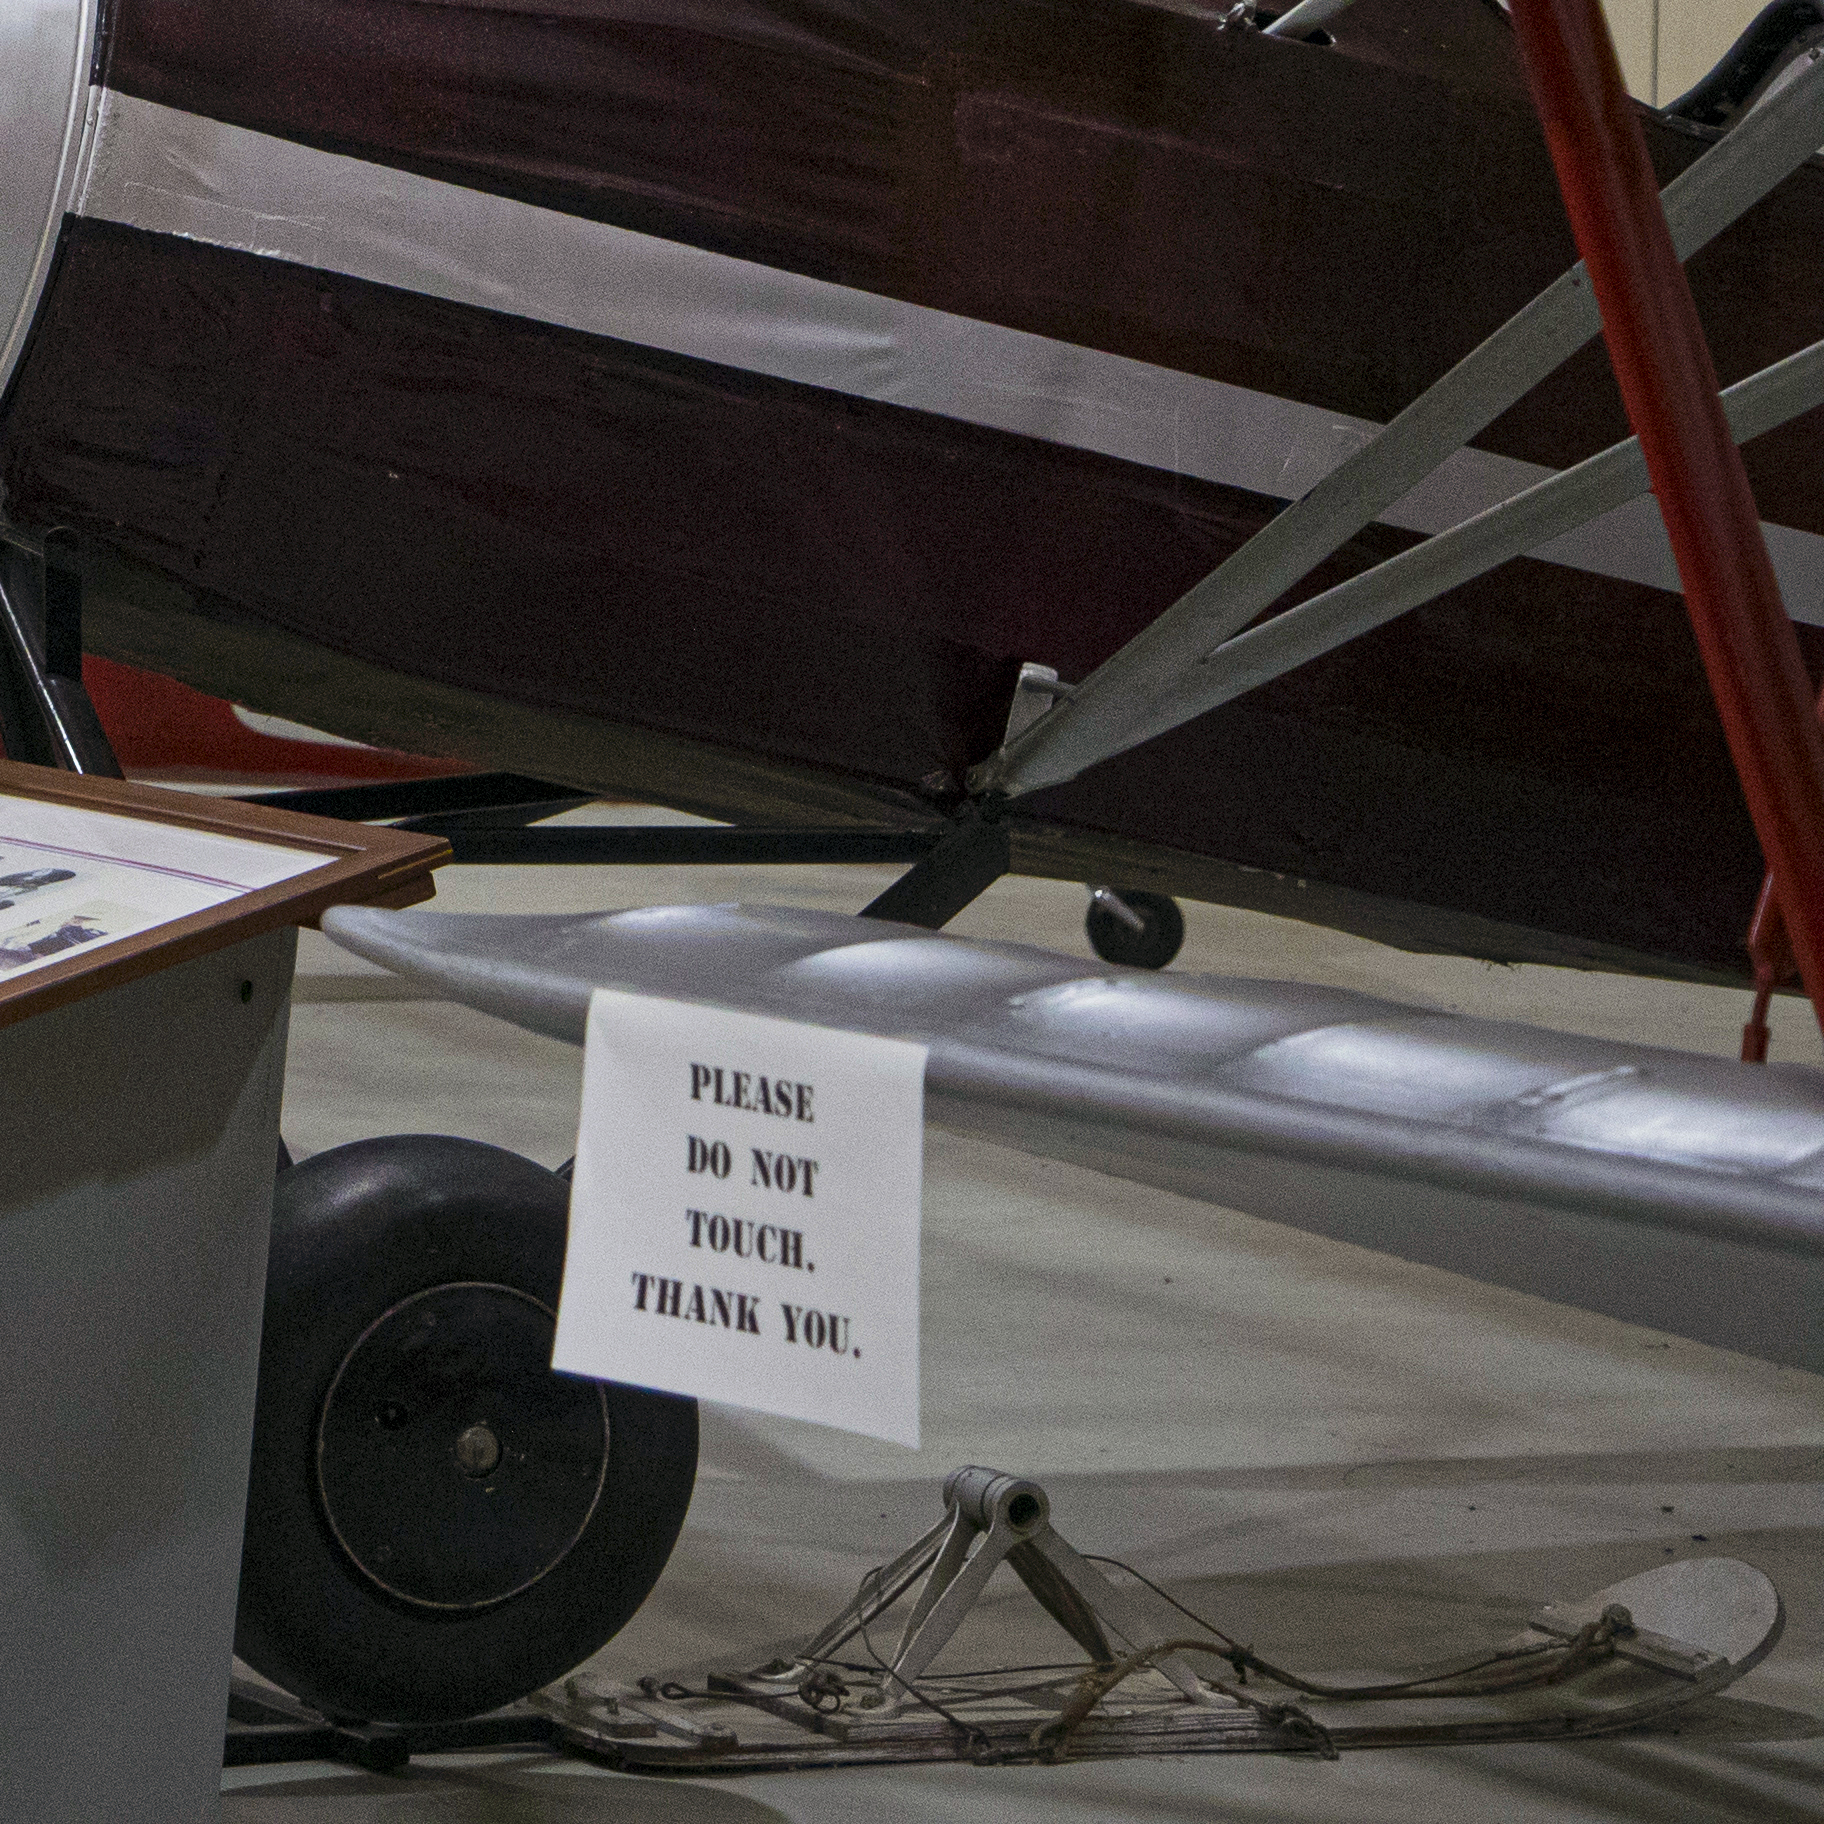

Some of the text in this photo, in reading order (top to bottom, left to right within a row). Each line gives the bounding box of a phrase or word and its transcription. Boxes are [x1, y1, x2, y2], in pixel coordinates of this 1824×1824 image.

[690, 1062, 815, 1124] PLEASE
[686, 1134, 820, 1198] DO NOT
[686, 1208, 816, 1273] TOUCH.
[631, 1271, 862, 1360] THANK YOU.
